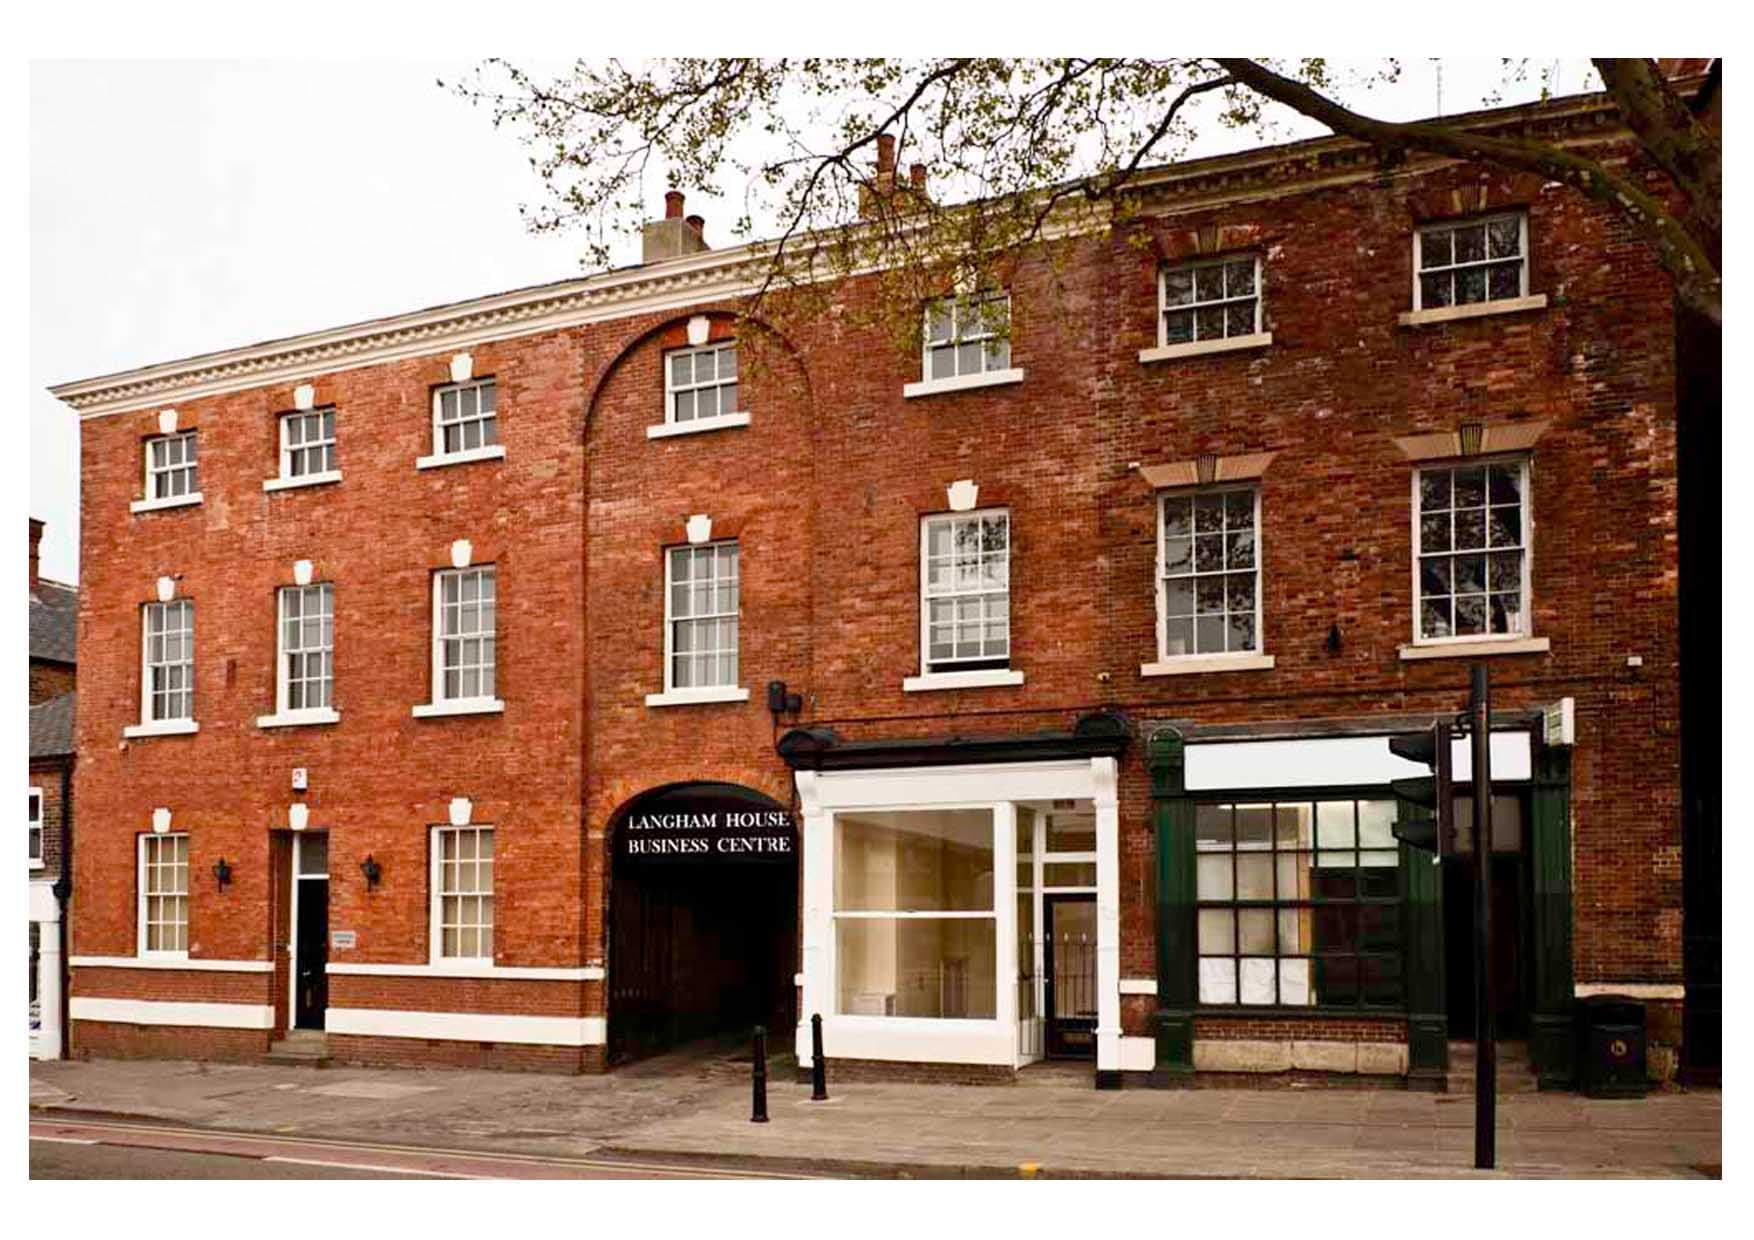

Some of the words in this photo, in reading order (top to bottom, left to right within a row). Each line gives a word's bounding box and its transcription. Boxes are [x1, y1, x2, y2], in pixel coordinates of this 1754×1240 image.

[629, 813, 717, 830] LANGHAM
[726, 812, 790, 828] HOUSE
[628, 838, 709, 854] BUSINESS
[717, 837, 791, 853] CENTRE
